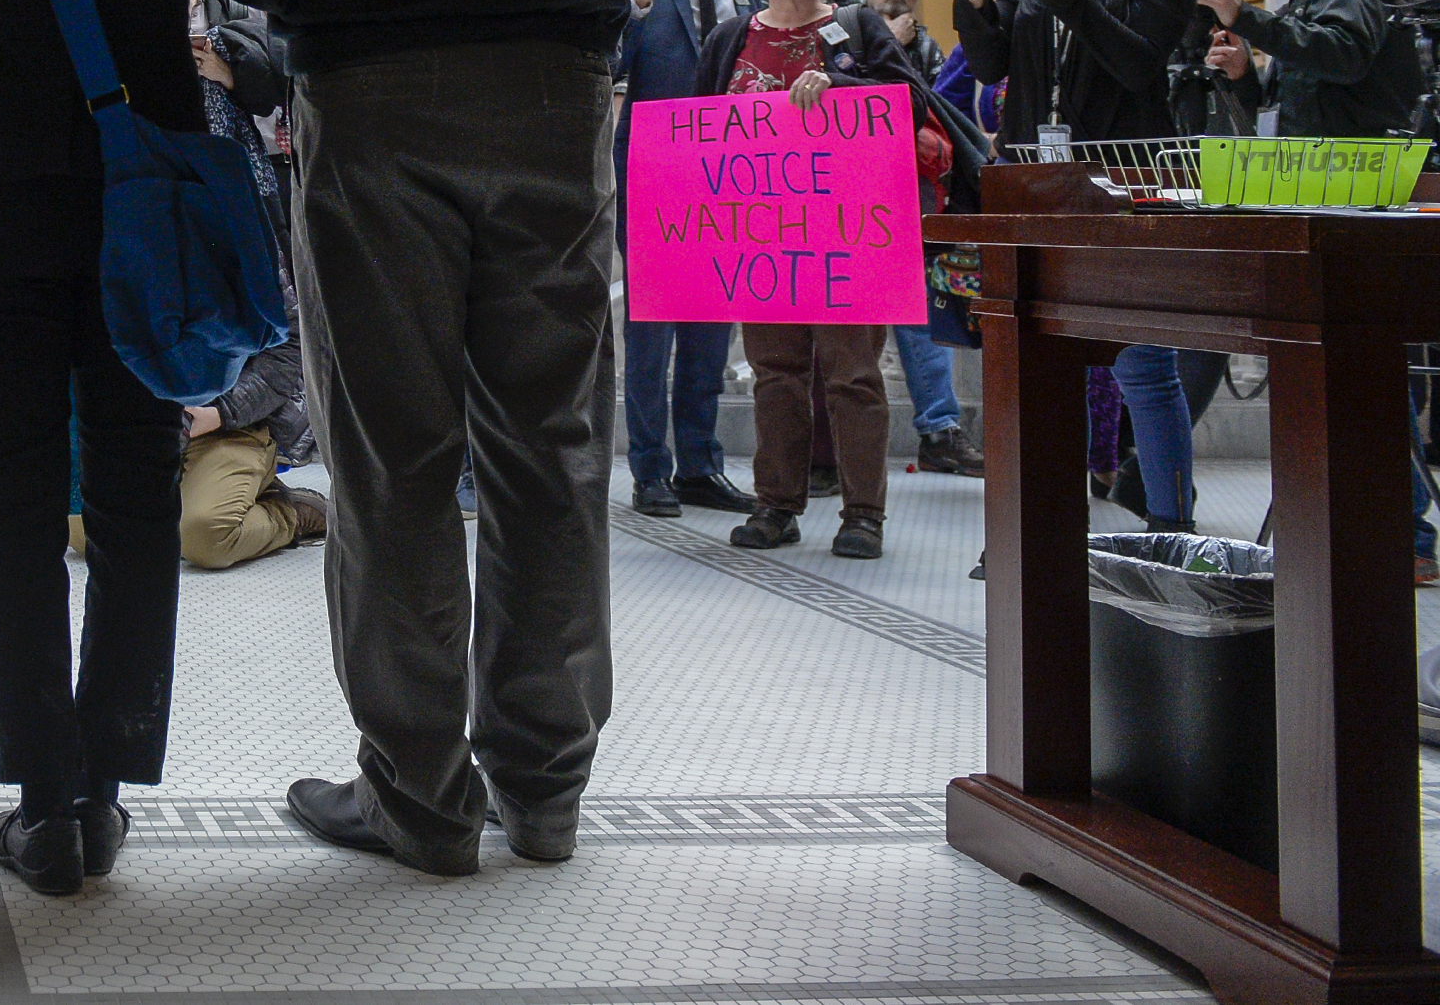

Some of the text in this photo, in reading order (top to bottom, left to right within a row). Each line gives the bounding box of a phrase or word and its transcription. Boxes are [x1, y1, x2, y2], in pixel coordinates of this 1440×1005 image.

[671, 95, 894, 142] HEAR OUR
[701, 151, 832, 196] VOICE
[656, 202, 892, 248] WATCH US
[713, 250, 852, 308] VOTE
